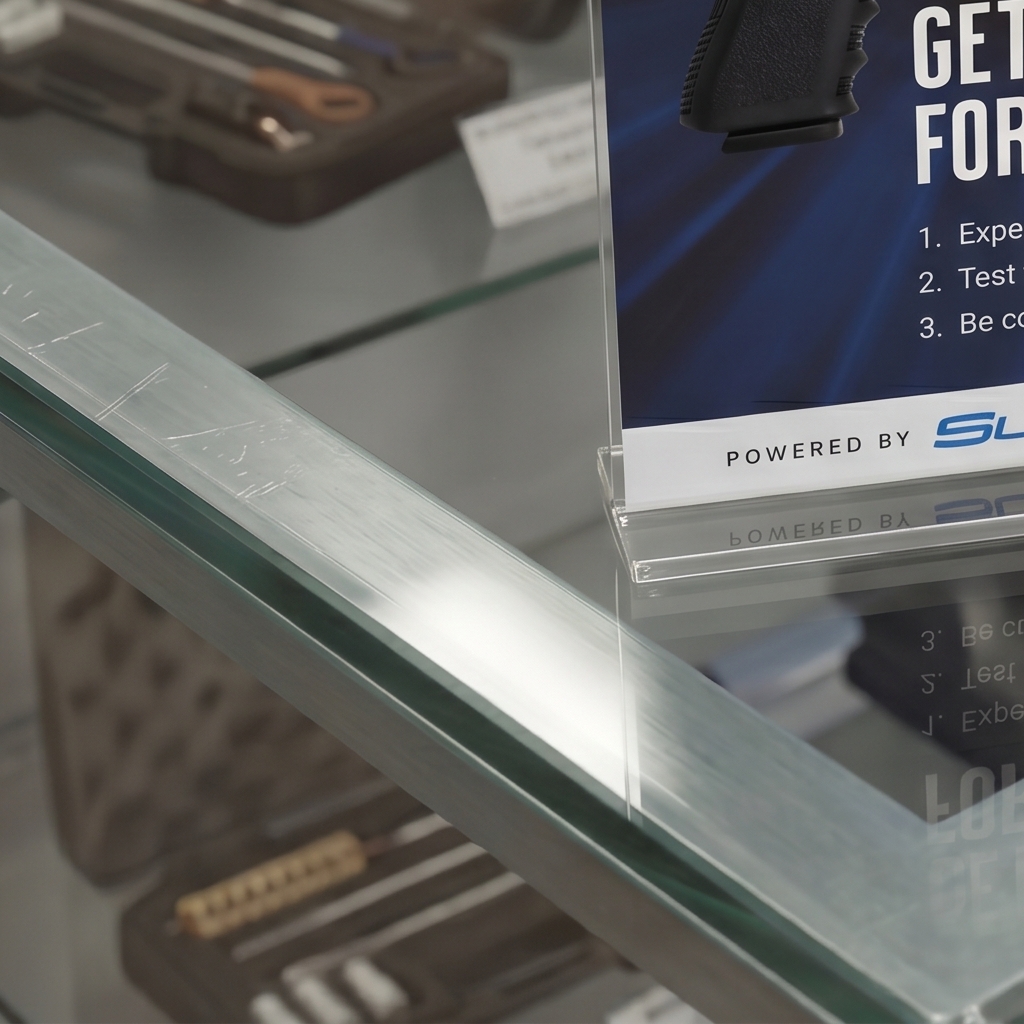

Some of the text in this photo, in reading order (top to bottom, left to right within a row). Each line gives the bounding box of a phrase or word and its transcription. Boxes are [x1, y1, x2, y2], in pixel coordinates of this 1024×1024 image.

[919, 226, 941, 249] 1.
[919, 271, 942, 294] 2.
[958, 264, 1016, 289] Test
[919, 316, 942, 339] 3.
[960, 312, 994, 335] Be
[726, 436, 863, 467] POWERED
[878, 431, 911, 450] BY
